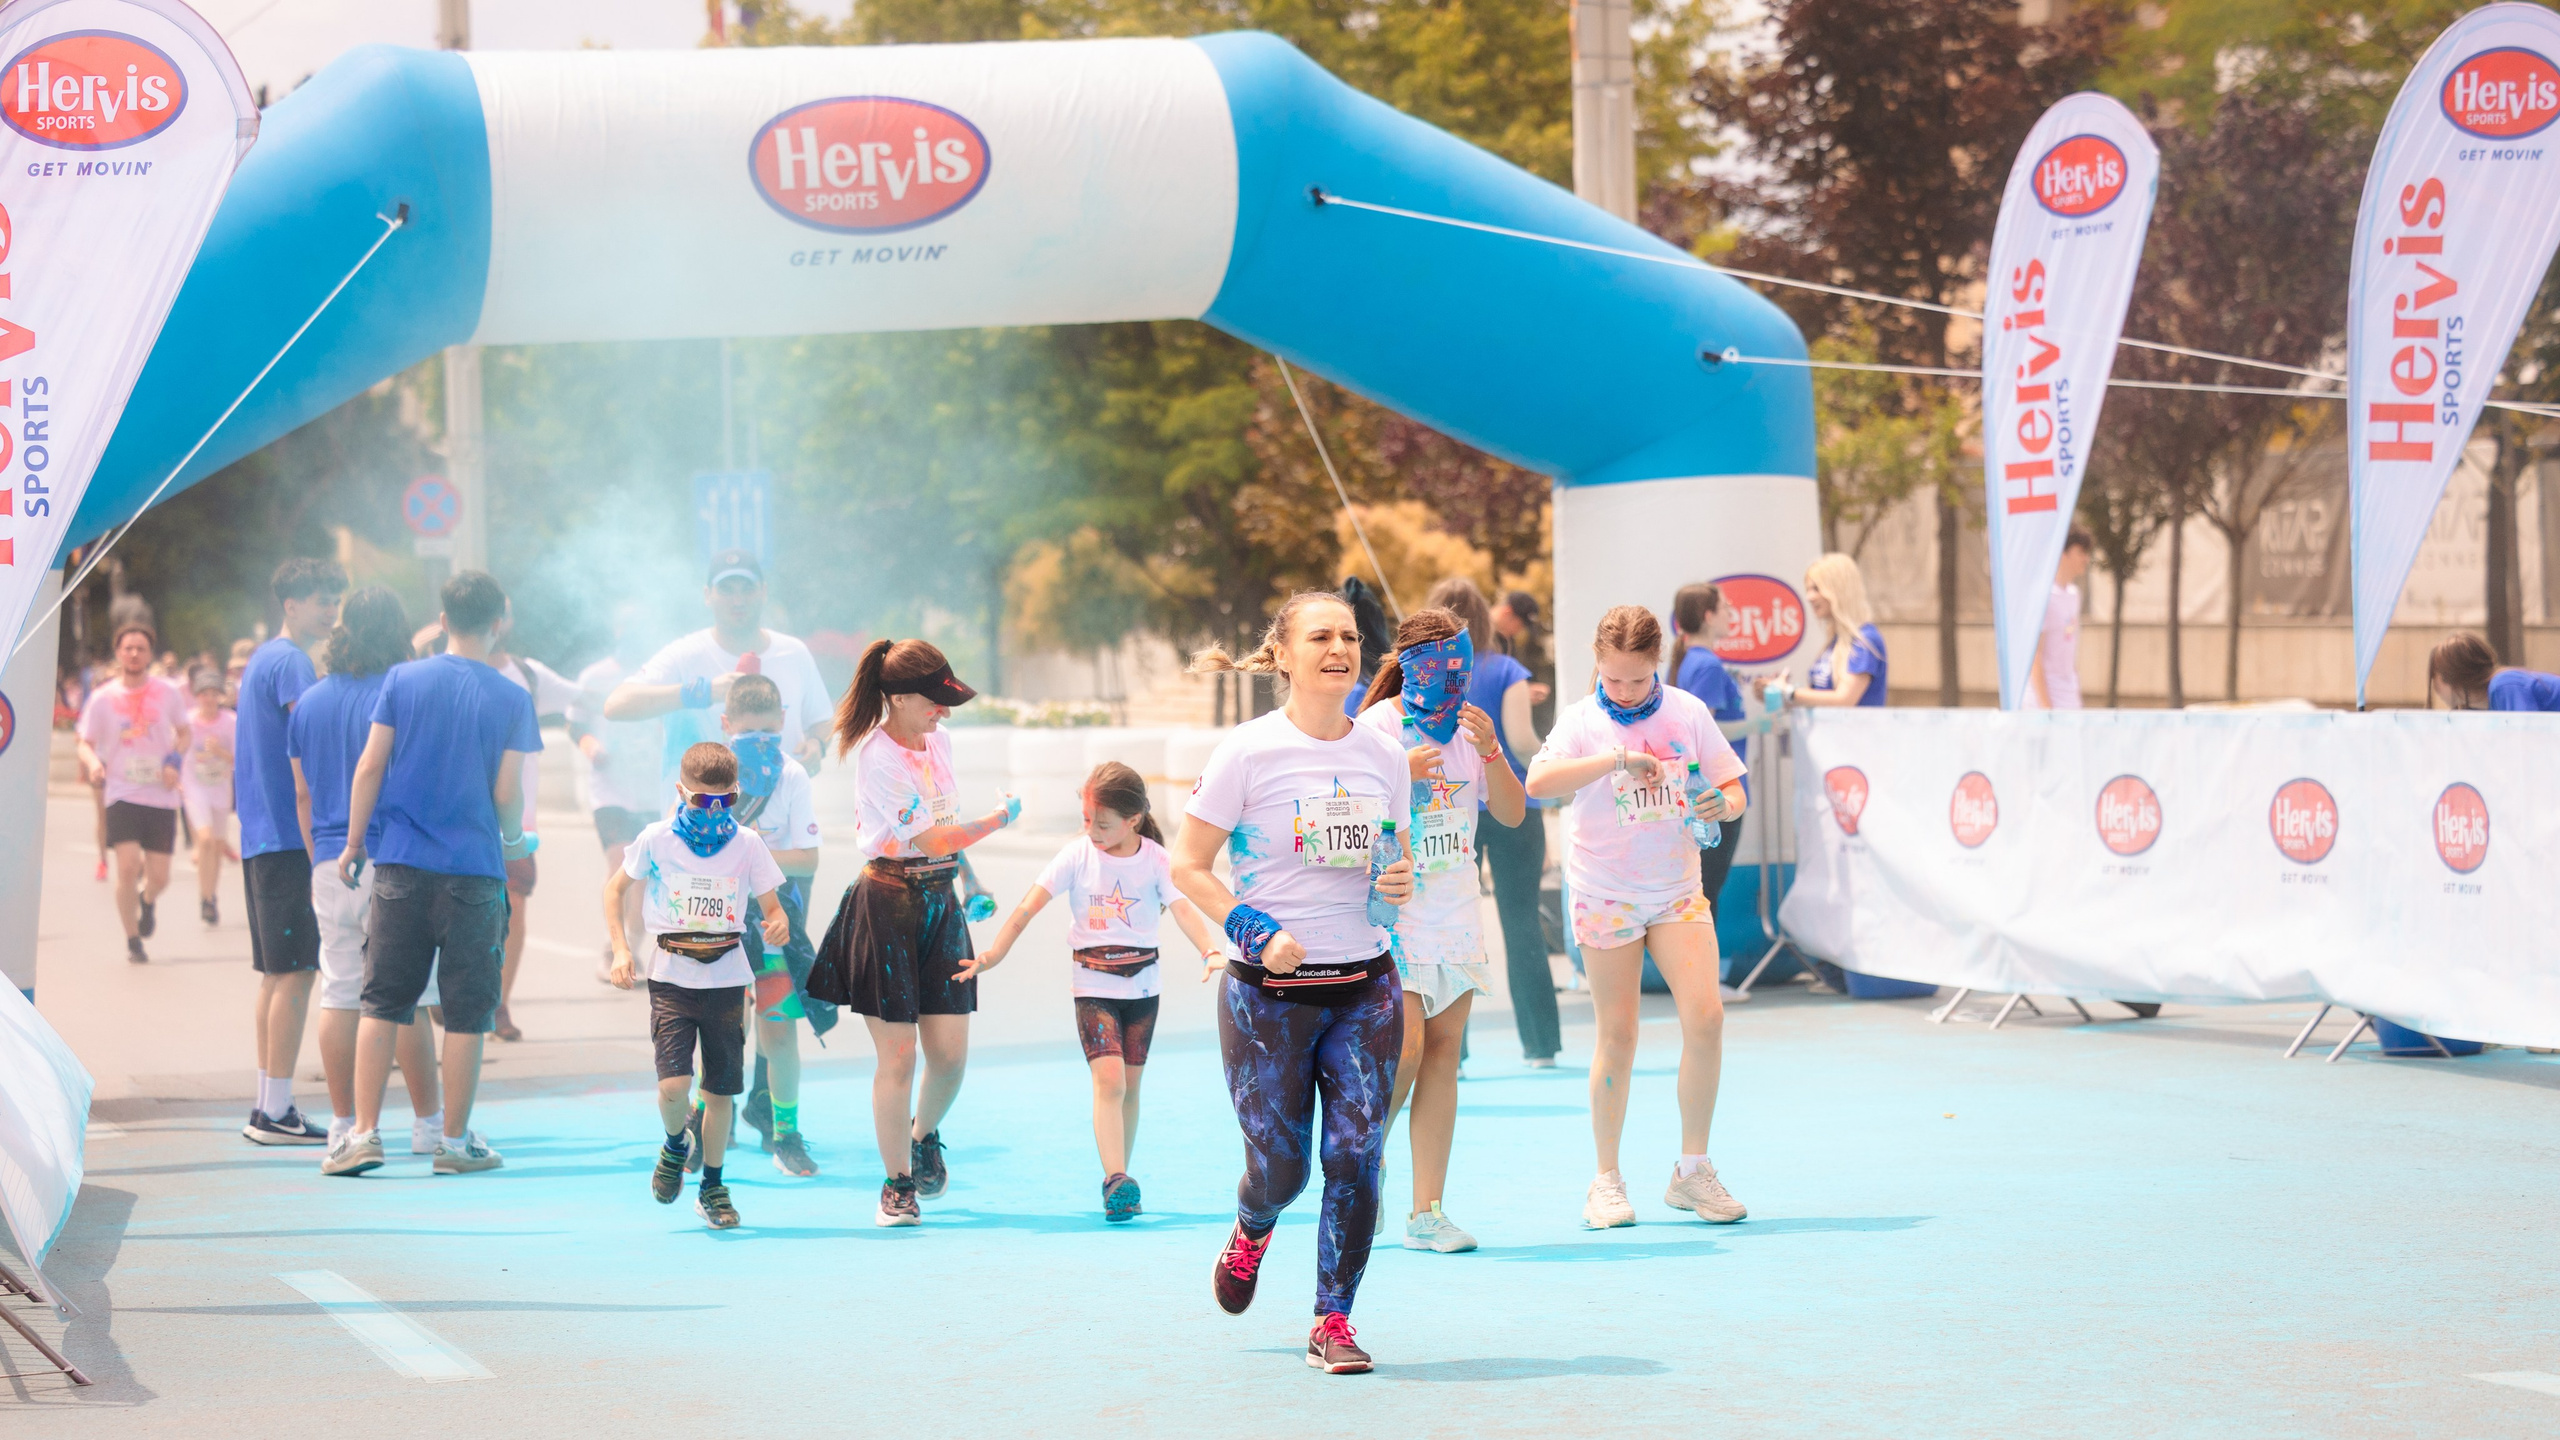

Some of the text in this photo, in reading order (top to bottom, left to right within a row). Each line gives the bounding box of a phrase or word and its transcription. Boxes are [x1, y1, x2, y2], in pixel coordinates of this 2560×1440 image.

[17, 62, 170, 123] Hervis
[2454, 70, 2558, 120] Hervis
[37, 115, 96, 130] SPORTS
[2466, 112, 2507, 125] SPORTS
[27, 161, 153, 177] GET MOVIN'
[774, 126, 972, 201] Hervis
[2043, 153, 2120, 199] Hervis
[2459, 149, 2486, 161] GET
[805, 191, 879, 212] SPORTS
[790, 249, 842, 267] GET
[2368, 177, 2458, 463] Hervis
[2003, 258, 2061, 515] Hervis
[2442, 315, 2463, 426] SPORTS
[22, 375, 49, 518] SPORTS
[2055, 378, 2074, 477] SPORTS
[1727, 597, 1800, 646] ervis
[1444, 678, 1465, 688] COLOR
[1446, 671, 1459, 679] THE
[1326, 824, 1369, 851] 17362
[2101, 792, 2157, 839] Hervis
[2275, 797, 2333, 847] Hervis
[2437, 803, 2486, 854] Hervis
[1423, 832, 1459, 857] 17174
[688, 896, 723, 918] 17289
[1089, 895, 1105, 906] THE
